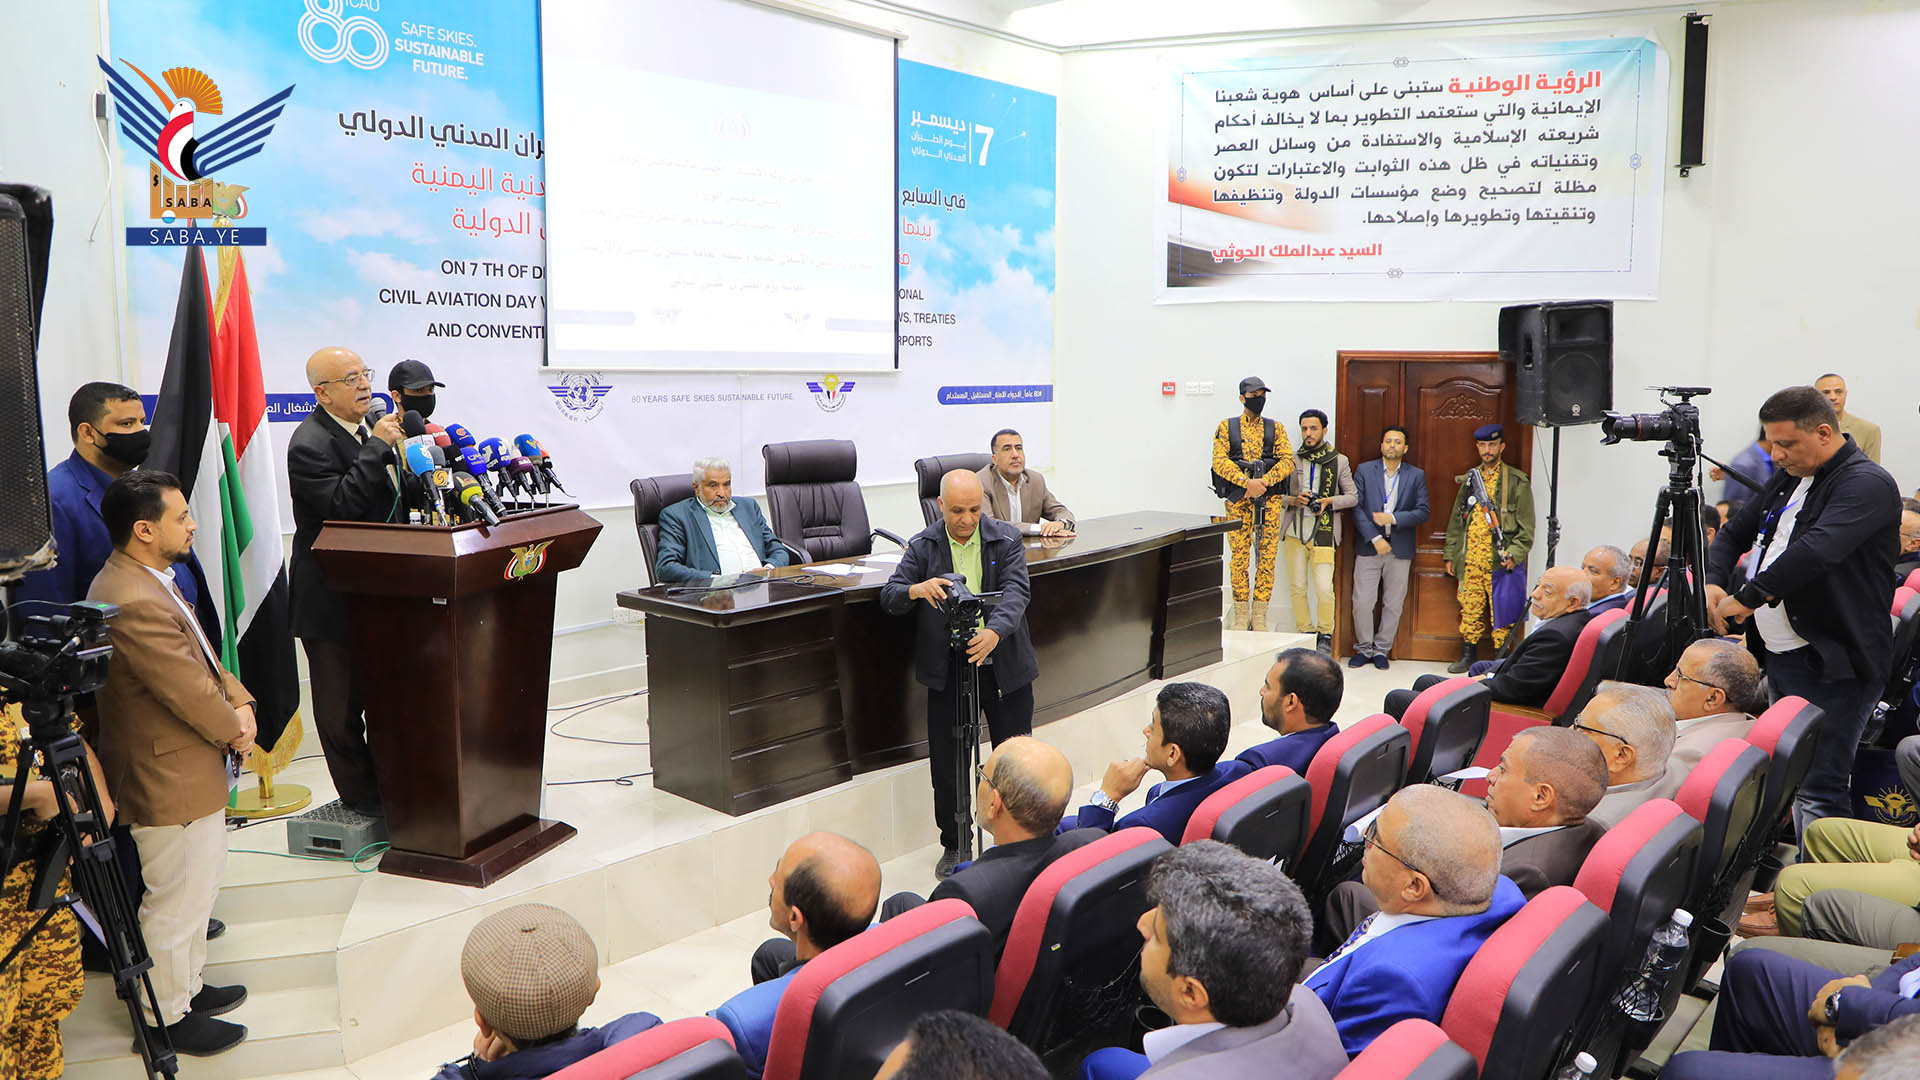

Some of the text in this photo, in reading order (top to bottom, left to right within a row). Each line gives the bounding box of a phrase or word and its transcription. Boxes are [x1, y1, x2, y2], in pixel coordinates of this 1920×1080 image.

[401, 21, 477, 48] SAFE SKIES.
[394, 38, 485, 66] SUSTAINABLE
[412, 59, 469, 80] FUTURE.
[1215, 70, 1601, 106] الرؤية الوطنية ستبنى على أساس هوية شعبنا
[338, 109, 424, 141] الدولي
[910, 110, 966, 135] ديسمبر
[1214, 99, 1601, 133] الإيمانية والتي ستعتمد التطوير بما لا يخالف أحكام
[430, 123, 509, 149] المدني
[975, 123, 994, 166] 7
[1213, 125, 1600, 156] شريعته الإسلامية والاستفادة من وسائل العصر
[411, 162, 493, 196] اليمنية
[1213, 153, 1598, 182] وتقنياته في ظل هذه الثوابت والاعتبارات لتكون
[902, 186, 966, 211] في السابع
[1213, 180, 1597, 206] مظلة لتصحيح وضع مؤسسات الدولة وتنظيفها
[452, 207, 531, 238] الدولية
[902, 216, 931, 241] بينما
[1362, 206, 1596, 227] وتنقيتها وتطويرها وإصلاحها.
[1212, 242, 1382, 262] السيد عبدالملك الحوثي
[441, 259, 545, 280] ON 7 TH OF D
[379, 288, 422, 305] CIVIL
[426, 291, 501, 308] AVIATION
[506, 295, 537, 309] DAY
[427, 323, 462, 338] AND
[913, 312, 956, 325] TREATIES
[642, 394, 668, 403] YEARS
[670, 394, 690, 402] SAFE
[693, 394, 715, 402] SKIES
[717, 393, 765, 402] SUSTAINABLE
